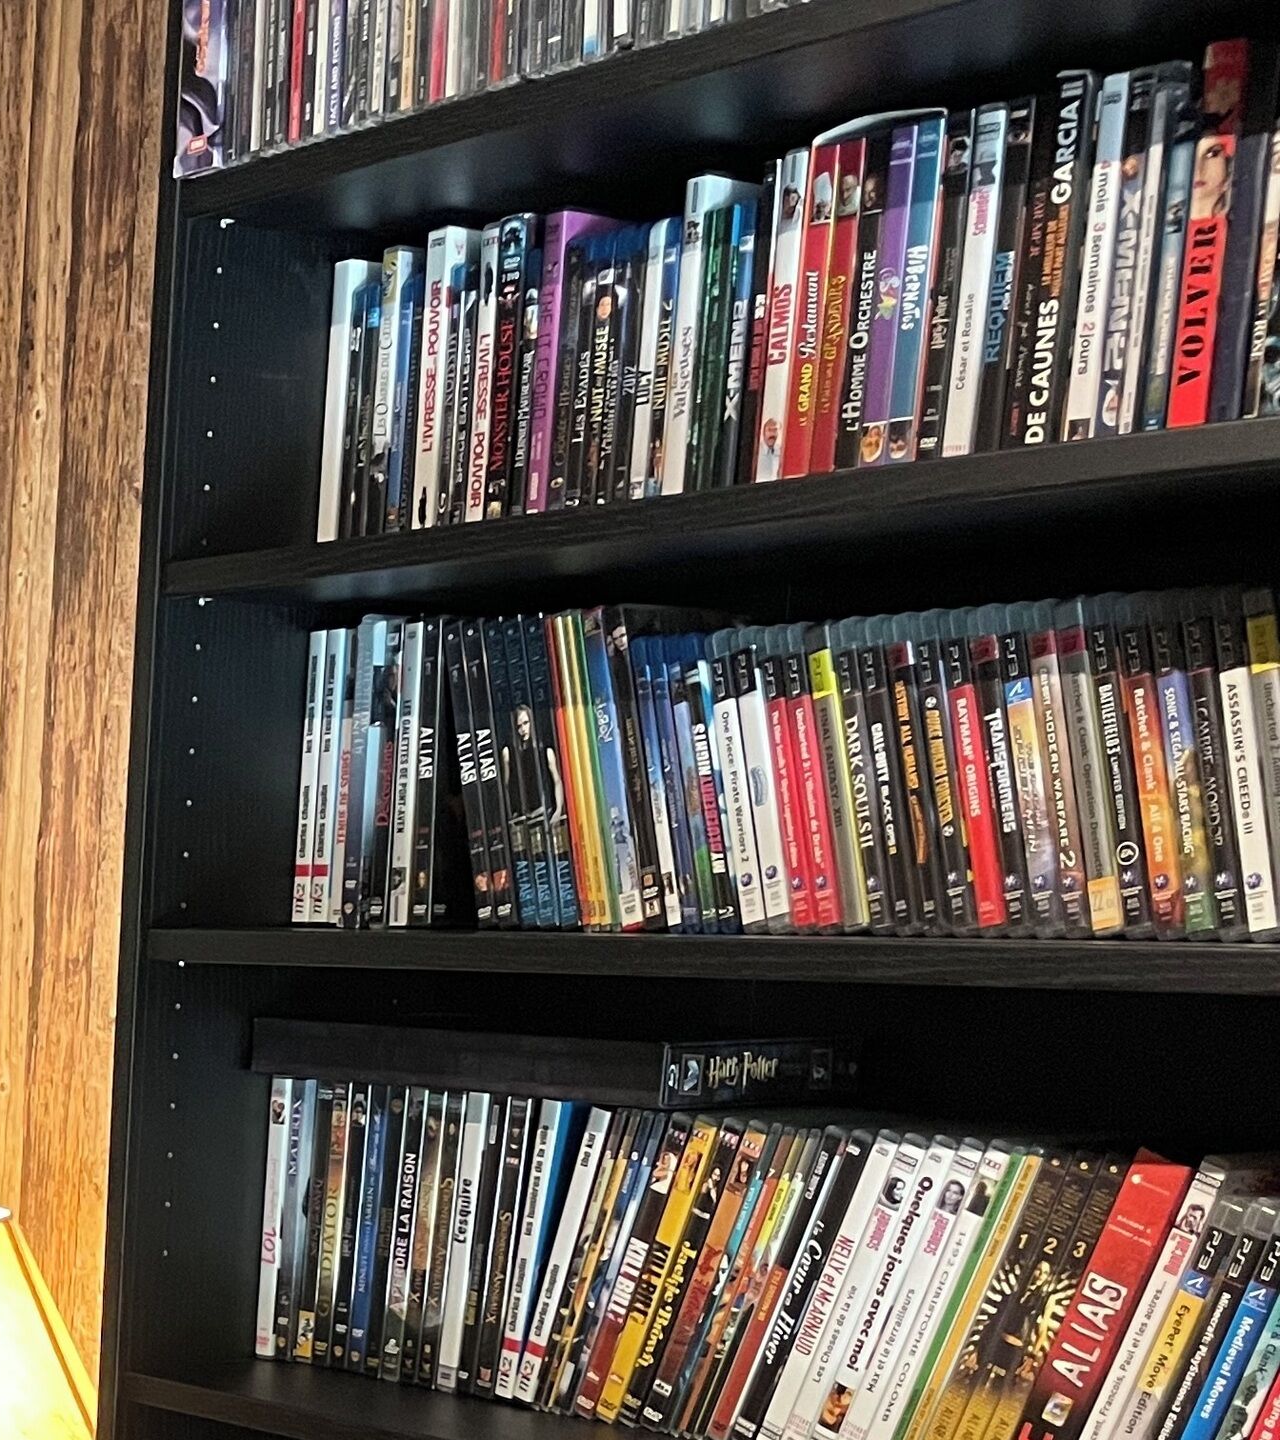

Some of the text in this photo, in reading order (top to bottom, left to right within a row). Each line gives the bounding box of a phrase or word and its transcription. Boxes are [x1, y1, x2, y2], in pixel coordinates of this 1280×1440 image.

[329, 94, 337, 125] FACTS
[331, 67, 339, 90] AND
[1051, 100, 1080, 205] GARCIA
[983, 252, 1010, 362] REQUIEM
[1077, 172, 1110, 375] mois semaines jours
[1176, 221, 1218, 386] VOLVER
[768, 283, 792, 365] CALMOS
[798, 271, 820, 412] GRAND Restaurant
[841, 249, 877, 431] L'HOMME ORCHESTRE
[955, 293, 976, 391] César et Rosalie
[422, 280, 442, 452] L'IVRESSE POUVOIR
[489, 320, 514, 471] MONSTER HOUSE
[622, 364, 637, 395] 2012
[636, 368, 652, 406] LUCY
[672, 326, 692, 420] Valseuses
[1024, 299, 1060, 444] DE CAUNES
[470, 334, 491, 507] L'IVRESSE POUVOIR
[591, 387, 604, 422] NUIT
[714, 662, 725, 698] PS3
[765, 661, 776, 697] PS3
[788, 659, 800, 697] PS3
[840, 657, 851, 695] PS3
[863, 652, 874, 689] PS3
[919, 646, 931, 683] PS3
[949, 646, 961, 686] PS3
[1005, 637, 1017, 678] PS3
[1093, 631, 1108, 670] PS3
[399, 723, 410, 765] GALETTES
[418, 726, 434, 779] ALIAS
[456, 732, 477, 786] ALIAS
[475, 728, 497, 782] ALIAS
[795, 708, 808, 759] Uncharted
[820, 708, 838, 800] FINAL FANTASY
[1164, 687, 1183, 758] SONIC SEGA
[375, 741, 394, 827] Descendants
[720, 711, 747, 854] One Pirate Warriors
[844, 715, 874, 833] DARK SOULS
[926, 710, 953, 824] DUKE NUKEM FOREVER
[965, 764, 980, 818] ORIGINS
[984, 708, 1016, 833] TRANSFORMERS
[1044, 710, 1075, 868] MODERN WARFARE 2
[1109, 756, 1122, 793] LIMITED
[1133, 688, 1165, 863] Ratchet Clank One
[1226, 684, 1253, 835] ASSASSIN'S III
[299, 785, 310, 858] charles chaplin
[316, 784, 328, 858] charles chaplin
[708, 1051, 779, 1095] Harry Potter
[287, 1098, 302, 1176] MATRIX
[261, 1227, 276, 1266] LOL
[392, 1152, 416, 1296] PERDRE LA RAISON
[453, 1178, 473, 1245] L'esquive
[1043, 1237, 1058, 1255] 2
[607, 1237, 649, 1317] KILL BILL
[643, 1240, 671, 1280] KILL
[662, 1241, 698, 1304] Jackie
[820, 1235, 855, 1286] NELLY et
[846, 1176, 933, 1372] Quelques jours avec moi
[1072, 1241, 1088, 1258] 3
[1197, 1230, 1222, 1271] PS3
[1228, 1237, 1253, 1279] PS3
[507, 1257, 527, 1333] charles chaplin
[533, 1263, 560, 1337] charles chaplin
[909, 1270, 951, 1357] CHRISTOPHE
[1051, 1271, 1128, 1388] ALIAS
[765, 1308, 797, 1364] Hiver
[812, 1285, 857, 1383] Les Choses de vie
[865, 1288, 915, 1393] Max ferrailleurs
[1118, 1321, 1148, 1373] Paul les
[1199, 1316, 1254, 1419] Medieval Moves
[881, 1361, 911, 1422] COLOMB
[1124, 1352, 1169, 1435] Move Edition
